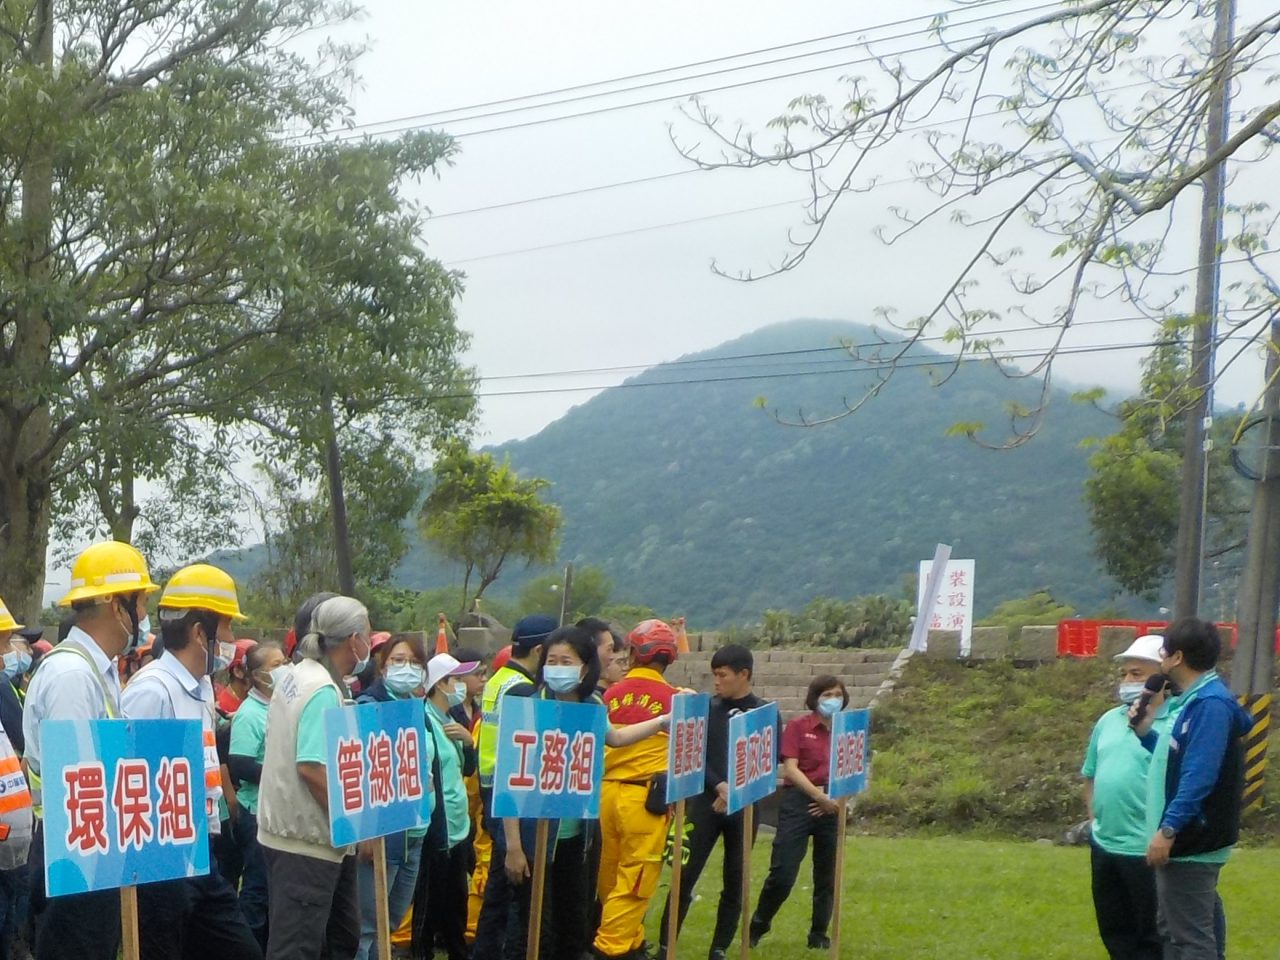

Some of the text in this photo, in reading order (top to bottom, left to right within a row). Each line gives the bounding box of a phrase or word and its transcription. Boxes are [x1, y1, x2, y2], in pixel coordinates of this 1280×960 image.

[336, 729, 423, 812] 管線組
[508, 730, 595, 793] 工務組
[63, 759, 195, 853] 環保組
